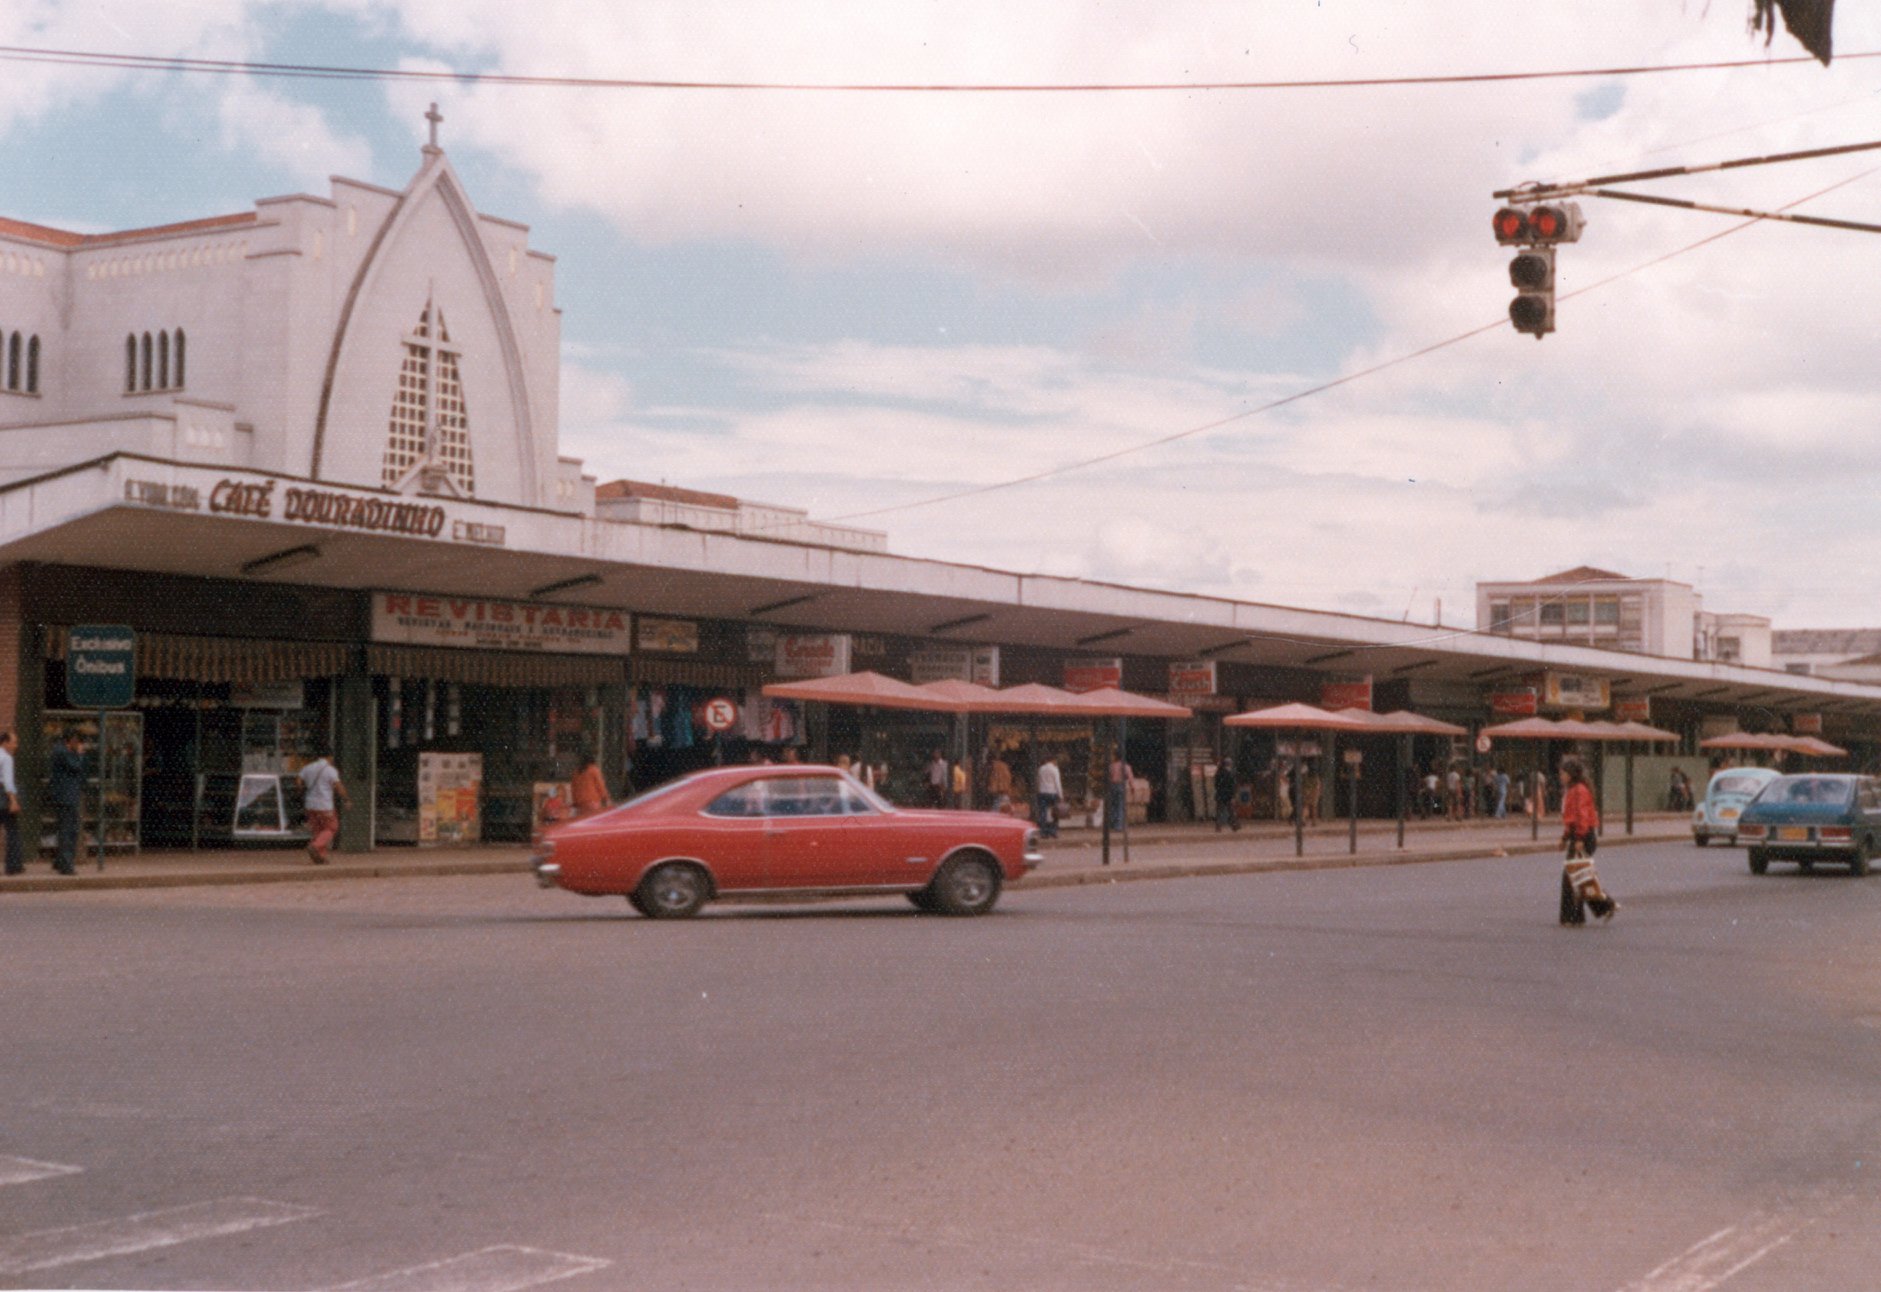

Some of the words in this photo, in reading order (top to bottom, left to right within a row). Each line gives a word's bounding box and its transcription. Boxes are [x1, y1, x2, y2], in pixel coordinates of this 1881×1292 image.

[210, 478, 275, 519] CAFÉ
[284, 486, 446, 538] DOURADINHO
[384, 594, 626, 632] REVISTARIA
[70, 636, 132, 651] Exclusivo
[75, 654, 126, 674] Ônibus
